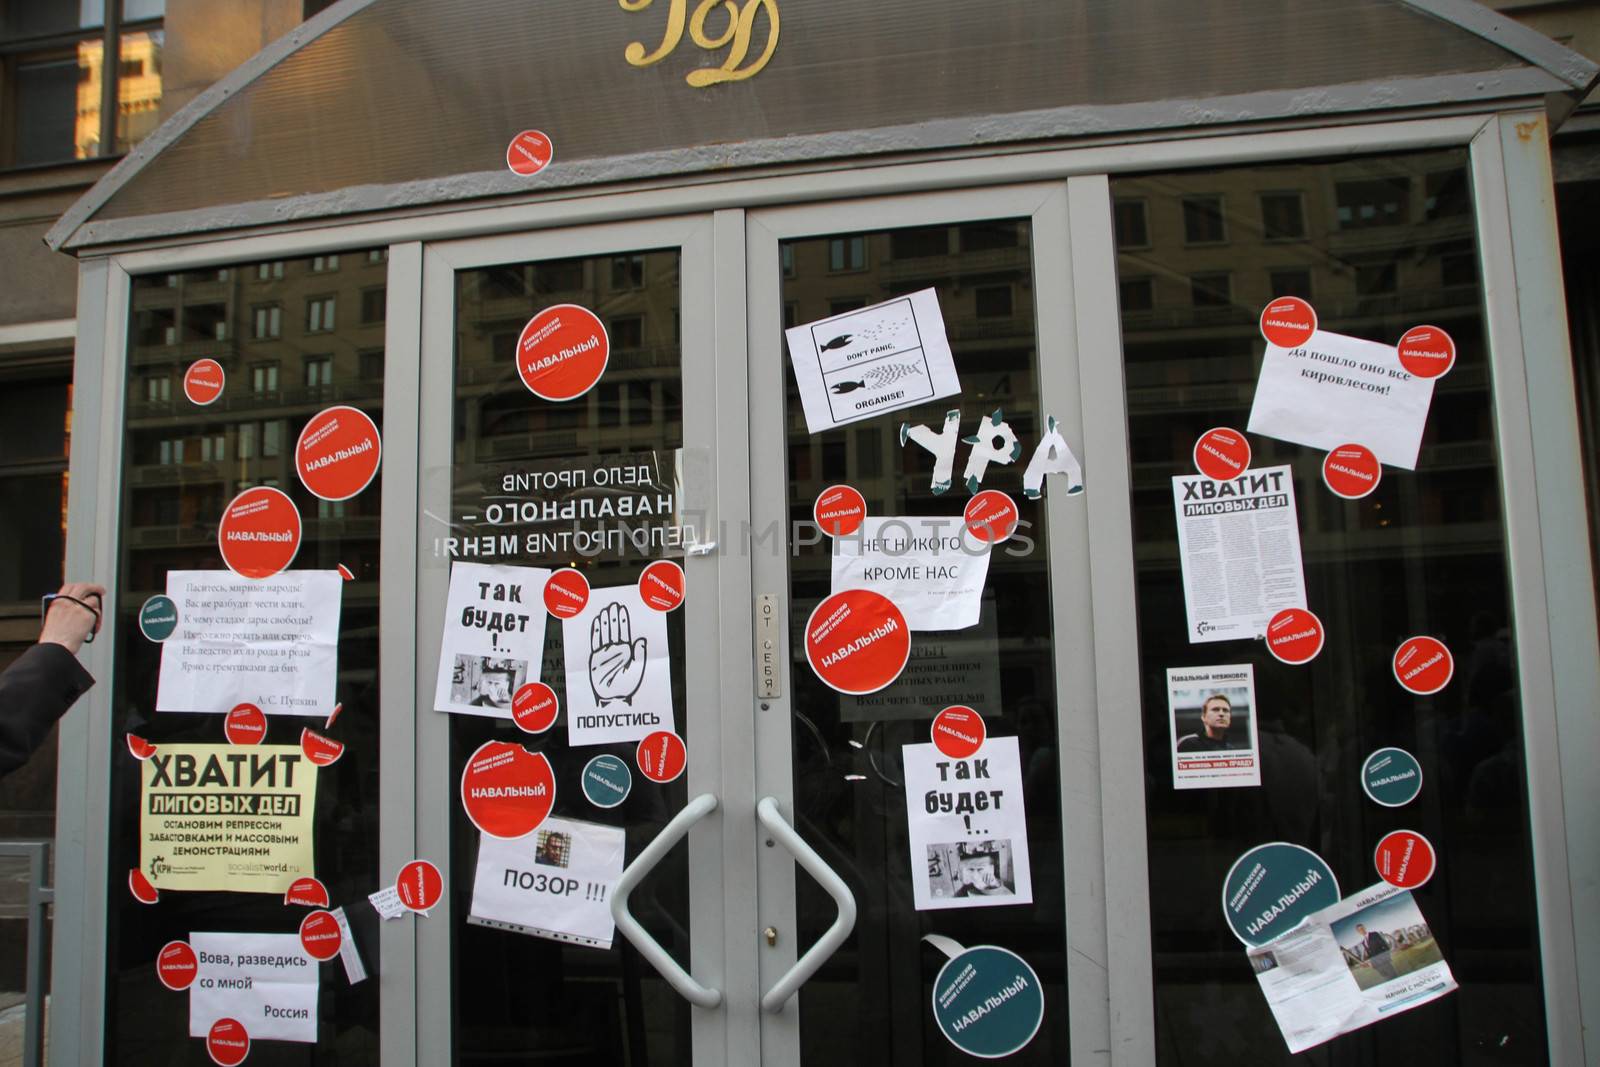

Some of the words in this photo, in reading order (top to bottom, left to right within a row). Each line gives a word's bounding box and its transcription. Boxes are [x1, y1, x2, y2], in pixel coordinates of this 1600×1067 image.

[1266, 318, 1310, 331] НАВАЛЬНЫЙ
[527, 334, 600, 374] НАВАЛЬНЫЙ
[847, 350, 868, 361] DON'T
[1403, 349, 1448, 360] НАВАЛЬНЫЙ
[1310, 352, 1356, 368] пошло
[1360, 362, 1385, 376] оно
[1388, 368, 1411, 381] все
[1301, 368, 1391, 396] кировлесом!
[855, 391, 905, 410] ORGANISE!
[305, 437, 373, 473] НАВАЛЬНЫЙ
[900, 408, 1084, 500] УРА
[1329, 462, 1373, 482] НАВАЛЬНЫЙ
[1182, 472, 1284, 500] ХВАТИТ
[821, 505, 862, 520] НАВАЛЬНЫЙ
[1186, 499, 1255, 516] ЛИПОВЫХ
[1259, 495, 1286, 509] ДЕЛ
[227, 529, 293, 542] НАВАЛЬНЫЙ
[861, 538, 890, 552] НЕТ
[895, 536, 961, 551] НИКОГО
[864, 566, 920, 581] КРОМЕ
[926, 565, 958, 579] НАС
[461, 606, 529, 633] будет
[763, 604, 772, 628] ОТ
[821, 617, 899, 668] НАВАЛЬНЫЙ
[1273, 627, 1317, 646] НАВАЛЬНЫЙ
[764, 640, 773, 689] СЕБЯ
[1172, 672, 1210, 682] Навальный
[517, 698, 553, 719] НАВАЛЬНЫЙ
[577, 712, 661, 729] ПОПУСТИСЬ
[938, 723, 979, 745] НАВАЛЬНЫЙ
[150, 754, 301, 787] ХВАТИТ
[1371, 768, 1416, 788] НАВАЛЬНЫЙ
[472, 781, 547, 799] НАВАЛЬНЫЙ
[152, 796, 254, 814] ЛИПОВЫХ
[257, 796, 297, 816] ДЕЛ
[925, 790, 1003, 814] будет
[164, 820, 223, 829] ОСТАНОВИМ
[226, 820, 282, 830] РЕПРЕССИИ
[149, 832, 223, 843] ЗАБАСТОВКАМИ
[226, 833, 232, 842] И
[235, 834, 298, 844] МАССОВЫМИ
[173, 846, 270, 856] ДЕМОНСТРАЦИЯМИ
[156, 864, 172, 874] КРИ
[504, 869, 579, 897] ПОЗОР
[586, 882, 606, 902] !!!
[1246, 868, 1323, 937] НАВАЛЬНЫЙ
[200, 952, 234, 967] Вова,
[237, 953, 307, 968] разведись
[200, 978, 214, 988] со
[217, 976, 253, 990] мной
[264, 1005, 308, 1019] Россия
[951, 975, 1029, 1034] НАВАЛЬНЫЙ
